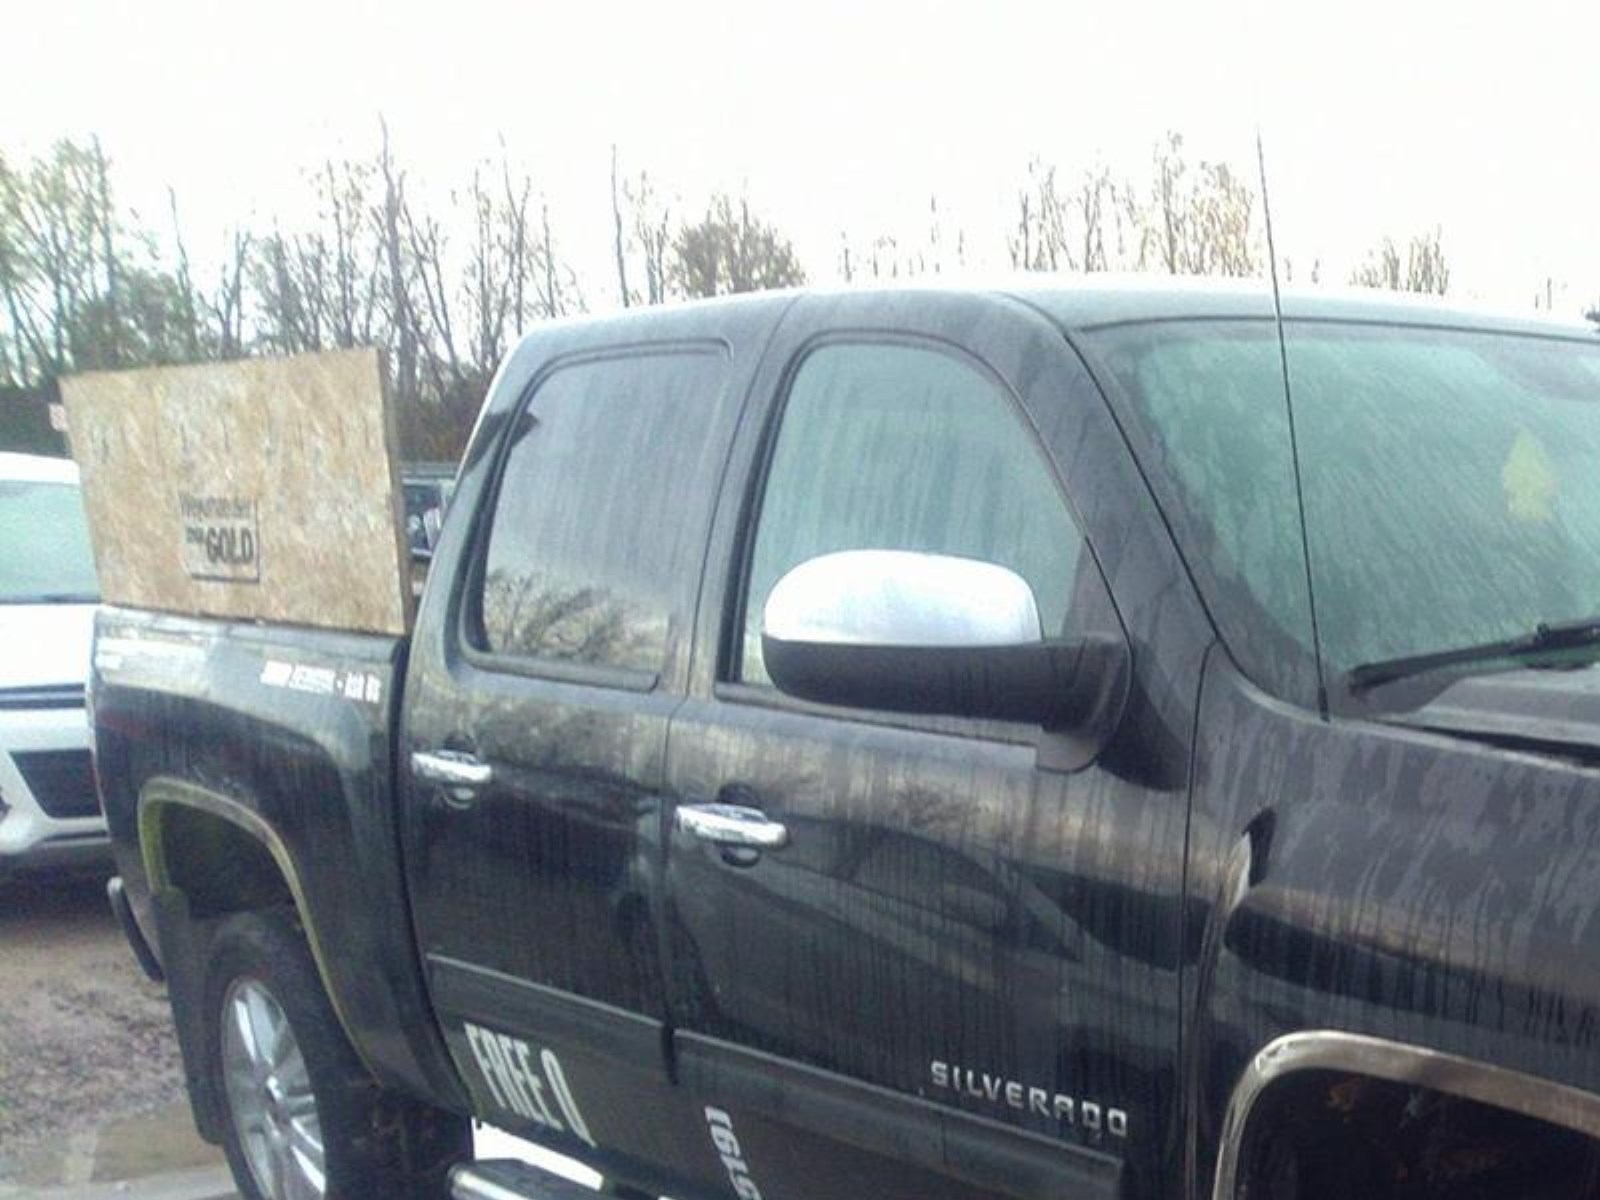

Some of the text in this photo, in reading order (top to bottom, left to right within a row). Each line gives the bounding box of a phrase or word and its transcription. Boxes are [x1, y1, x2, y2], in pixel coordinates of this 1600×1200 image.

[206, 526, 255, 565] GOLD
[463, 1021, 564, 1133] FREE
[930, 1059, 1129, 1138] SILVERADO
